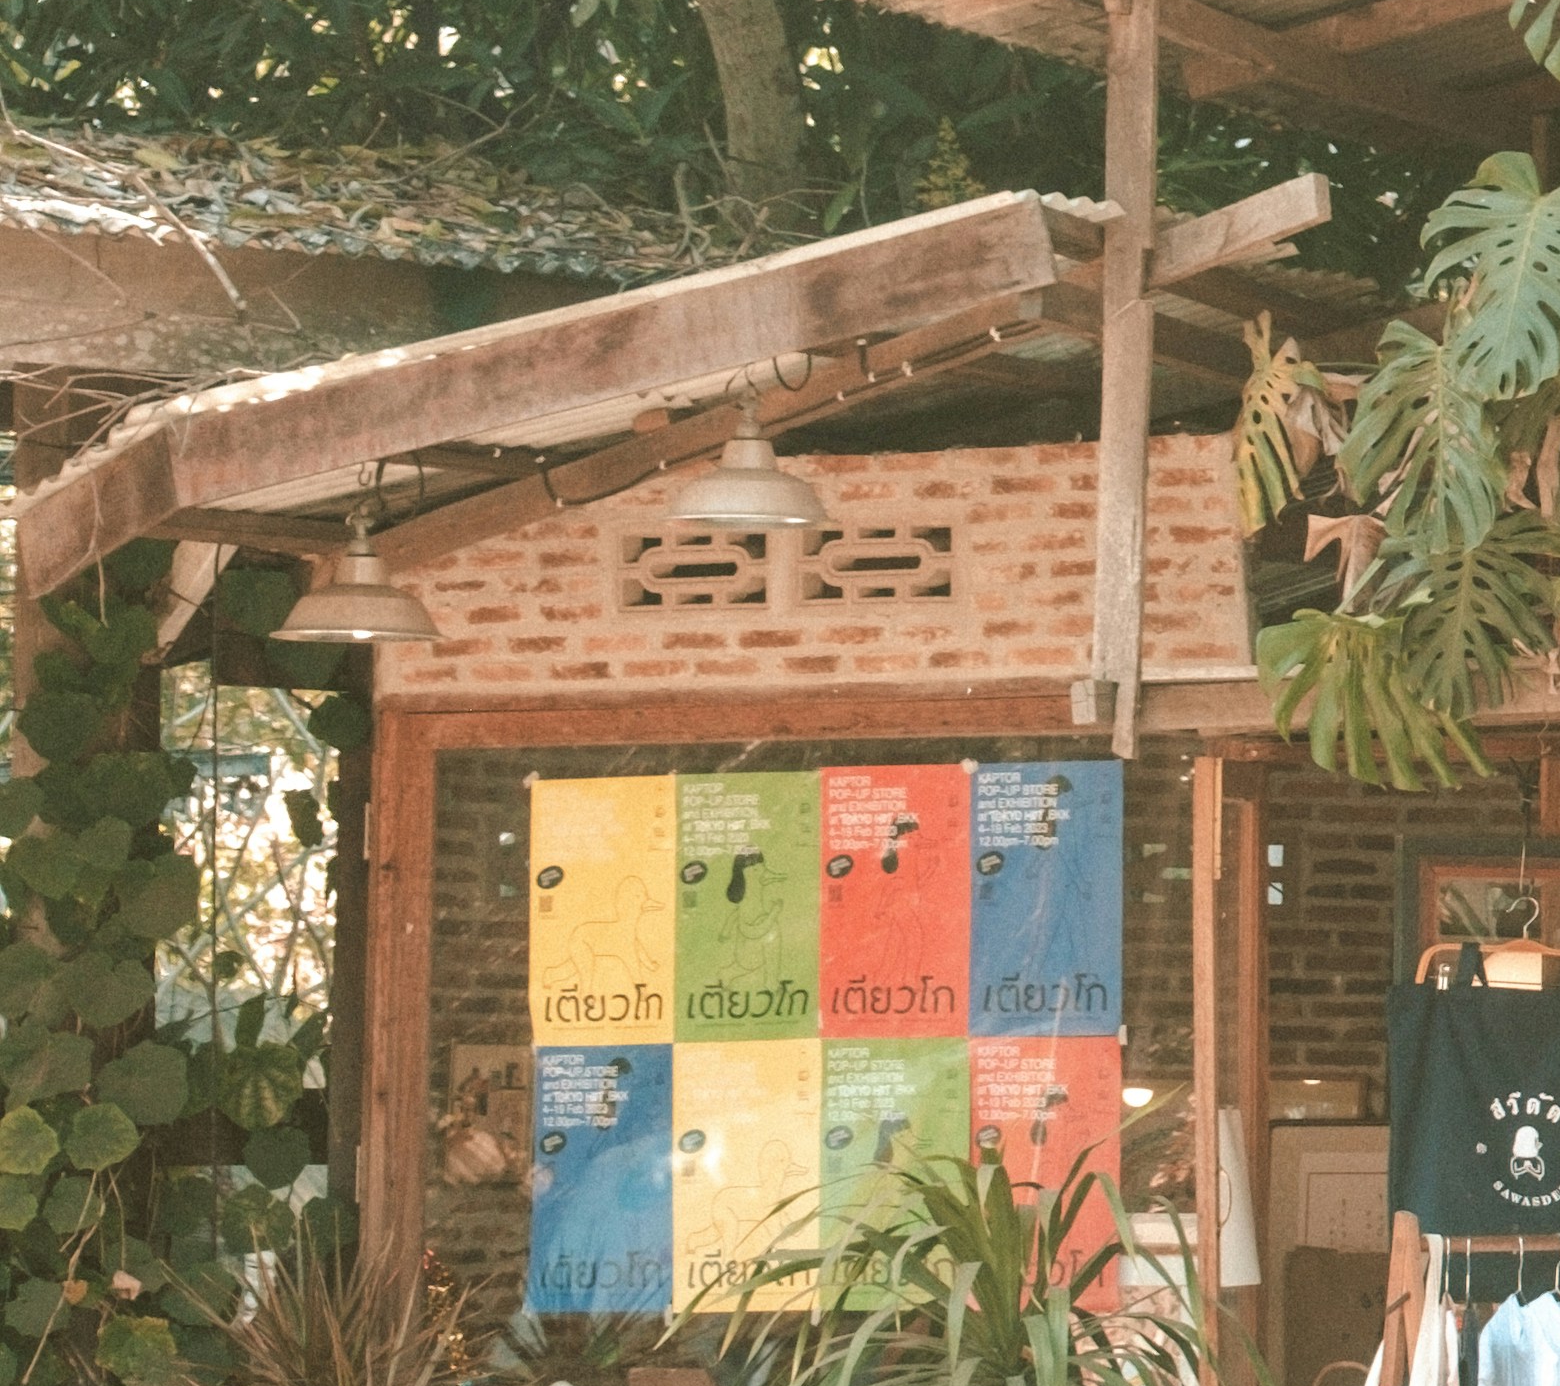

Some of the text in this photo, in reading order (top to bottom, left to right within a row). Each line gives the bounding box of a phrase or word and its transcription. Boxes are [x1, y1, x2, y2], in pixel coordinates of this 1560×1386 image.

[978, 772, 1021, 784] KAPTOR
[1022, 784, 1059, 795] STORE
[977, 797, 1057, 809] and EXHIBITION
[542, 1055, 584, 1066] KAPTOR
[584, 1065, 619, 1077] STORE
[543, 1079, 617, 1090] and EXHIBITION
